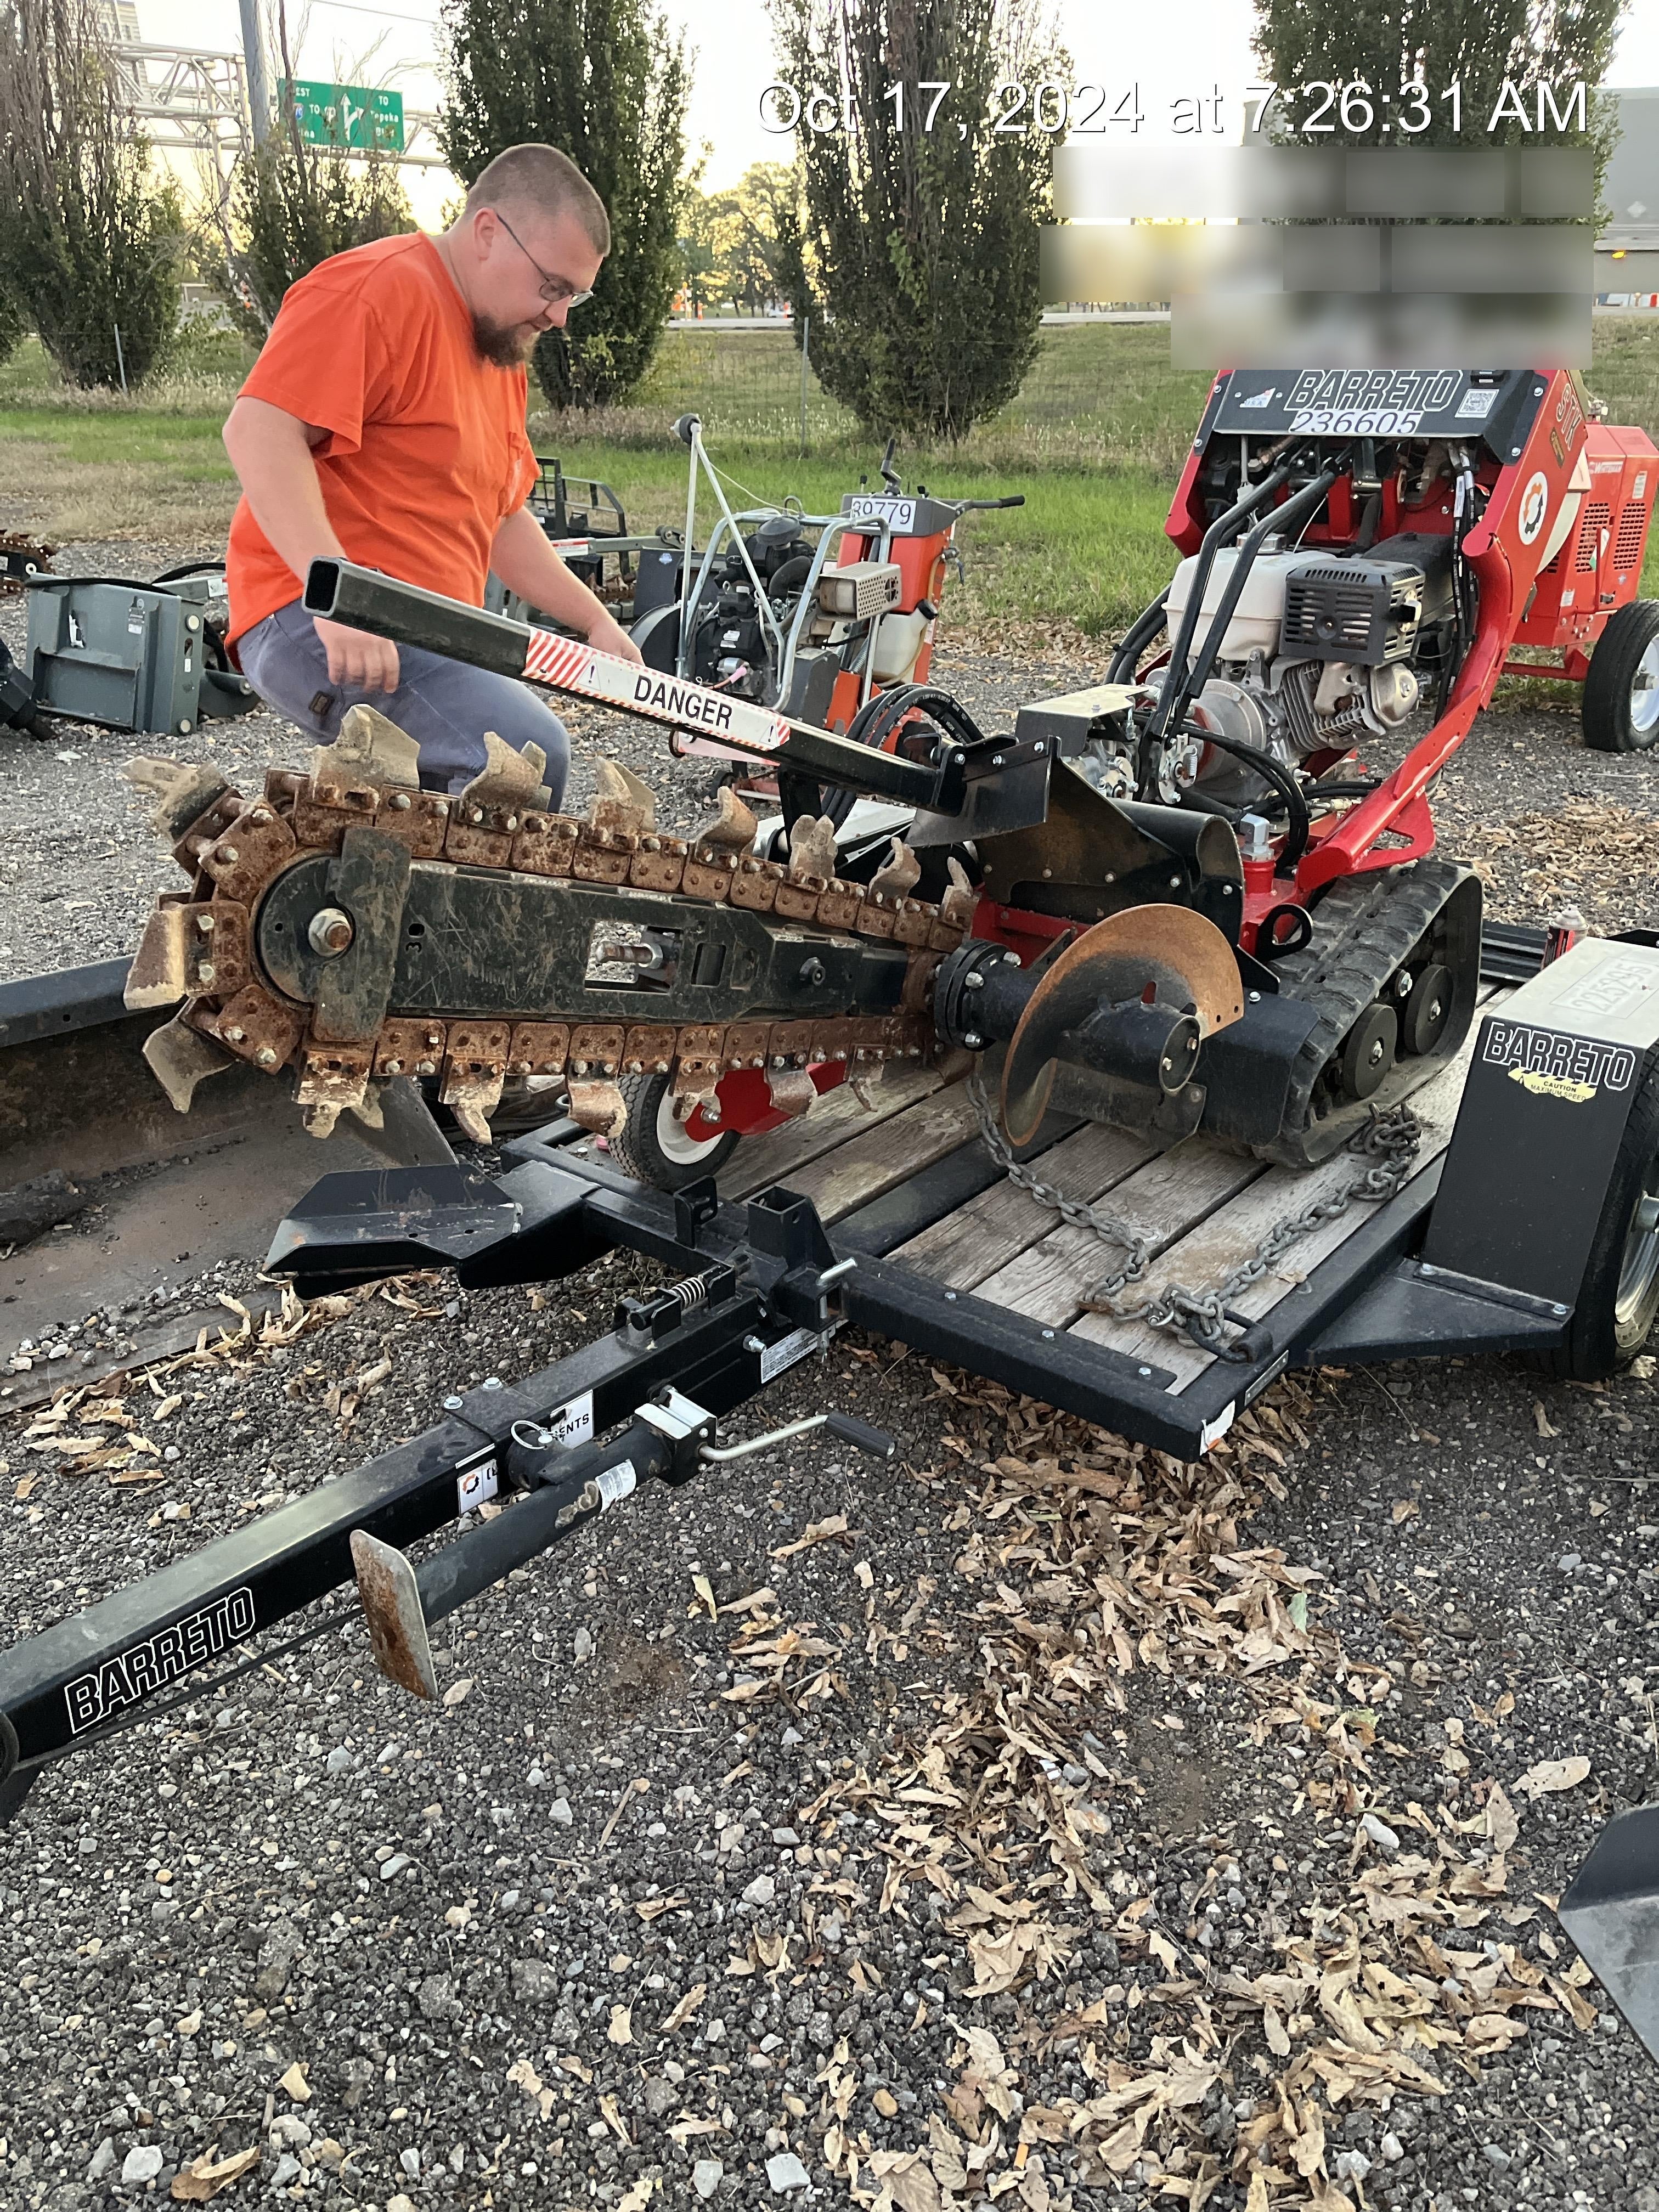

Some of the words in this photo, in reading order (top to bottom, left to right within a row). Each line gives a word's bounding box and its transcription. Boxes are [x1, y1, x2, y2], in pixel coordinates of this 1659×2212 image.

[295, 87, 310, 97] EST
[378, 95, 389, 106] TO
[309, 104, 320, 115] TO
[1283, 370, 1463, 412] BARRETO
[1290, 411, 1422, 434] 236605
[634, 674, 733, 730] DANGER
[1571, 963, 1652, 1012] 225295
[1482, 1021, 1636, 1091] BARRETO
[1530, 1084, 1562, 1096] MAXIMUM
[1564, 1091, 1587, 1101] SPEED
[1543, 1081, 1577, 1093] CAUTION
[556, 1413, 590, 1438] ENTS
[64, 1586, 256, 1734] BARRETO
